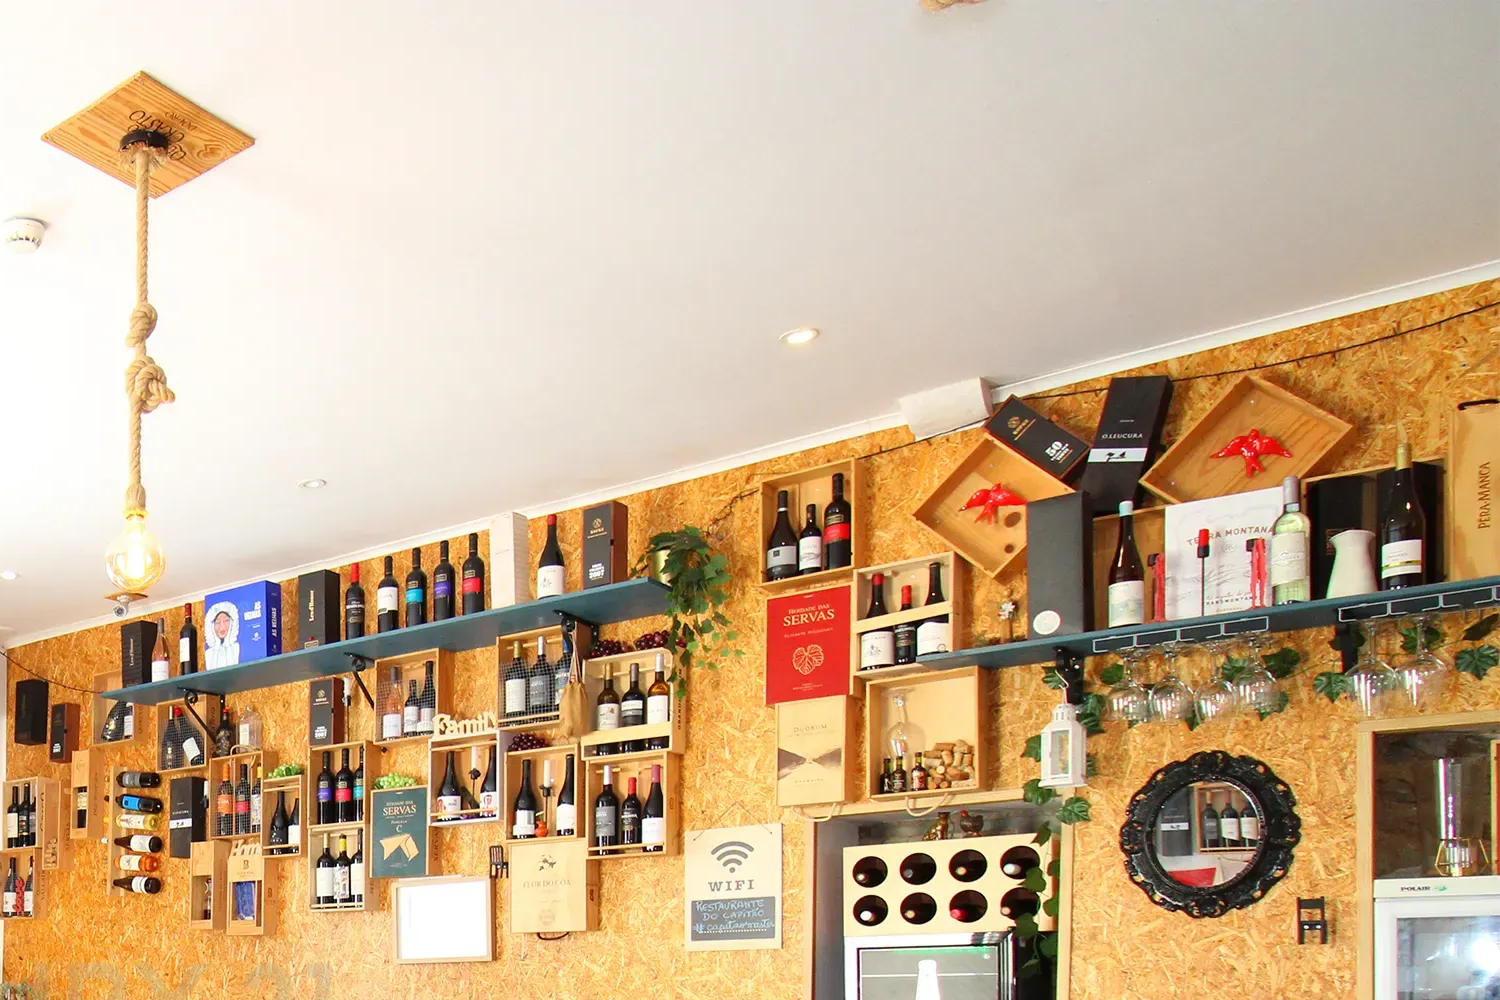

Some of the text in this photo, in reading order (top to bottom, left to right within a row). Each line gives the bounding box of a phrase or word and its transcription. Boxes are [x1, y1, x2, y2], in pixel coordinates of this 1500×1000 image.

[1186, 530, 1221, 547] TERA
[783, 608, 835, 627] SERVAS
[382, 804, 417, 816] SERVAS
[230, 839, 263, 858] Hom
[708, 879, 755, 892] WIFI
[695, 899, 765, 913] RESTAURANTE
[702, 912, 718, 922] DO
